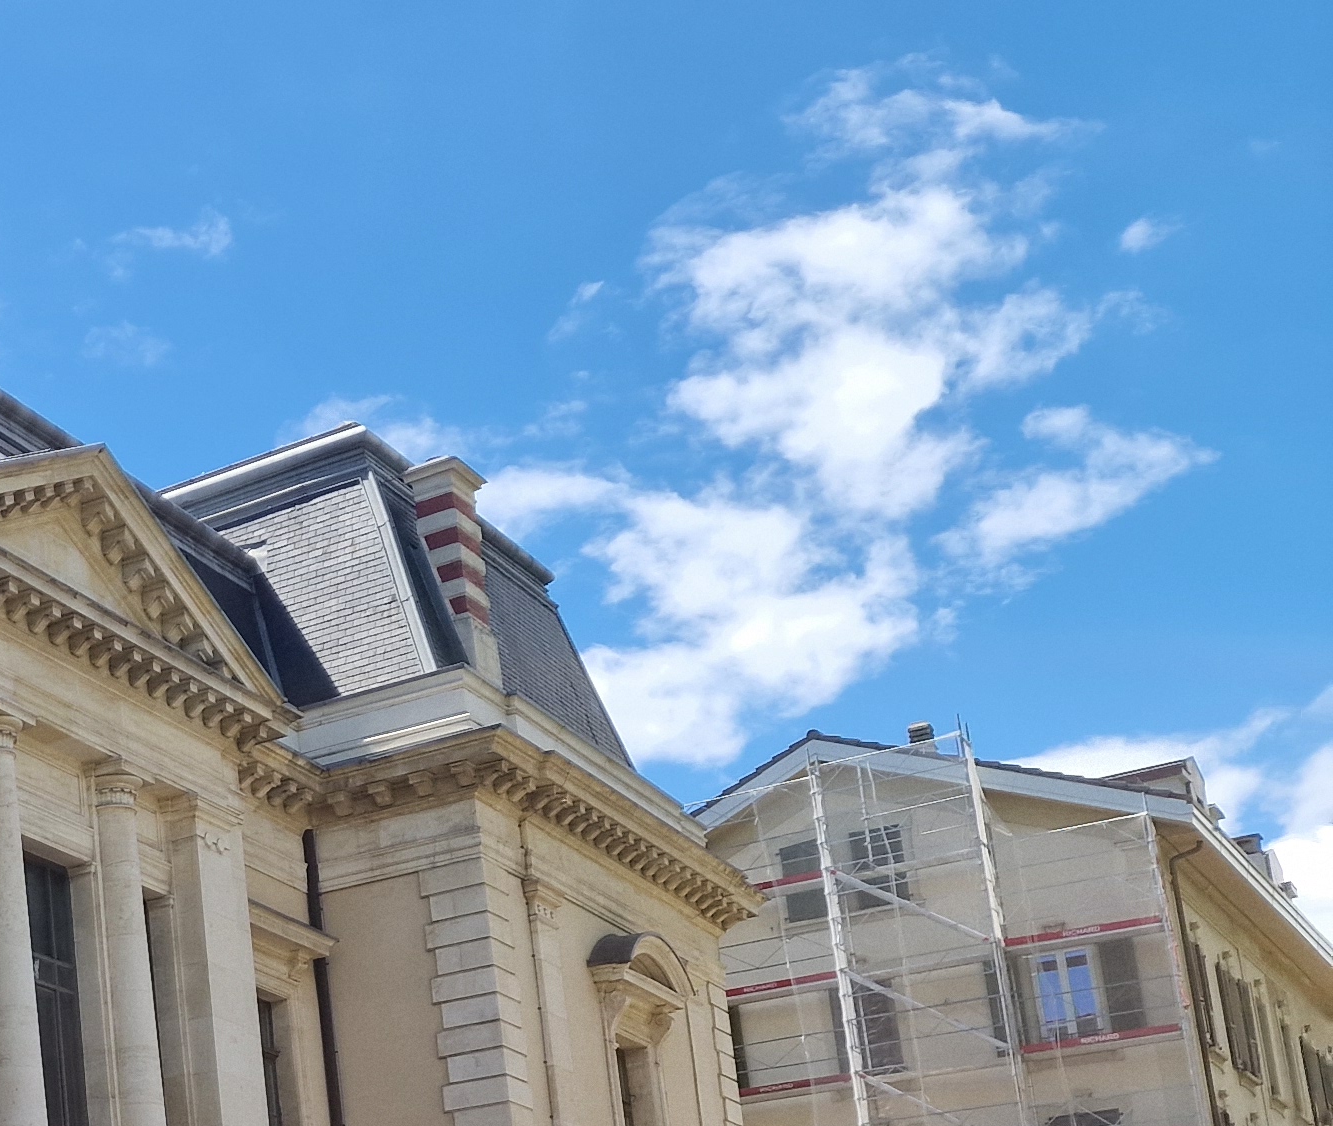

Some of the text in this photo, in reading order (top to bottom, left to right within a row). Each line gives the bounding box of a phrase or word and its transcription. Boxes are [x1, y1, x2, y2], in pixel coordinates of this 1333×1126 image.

[1062, 925, 1101, 937] RICHARD
[743, 982, 778, 993] RICHARD
[1080, 1032, 1120, 1044] RICHARD
[759, 1082, 794, 1093] RICHARD
